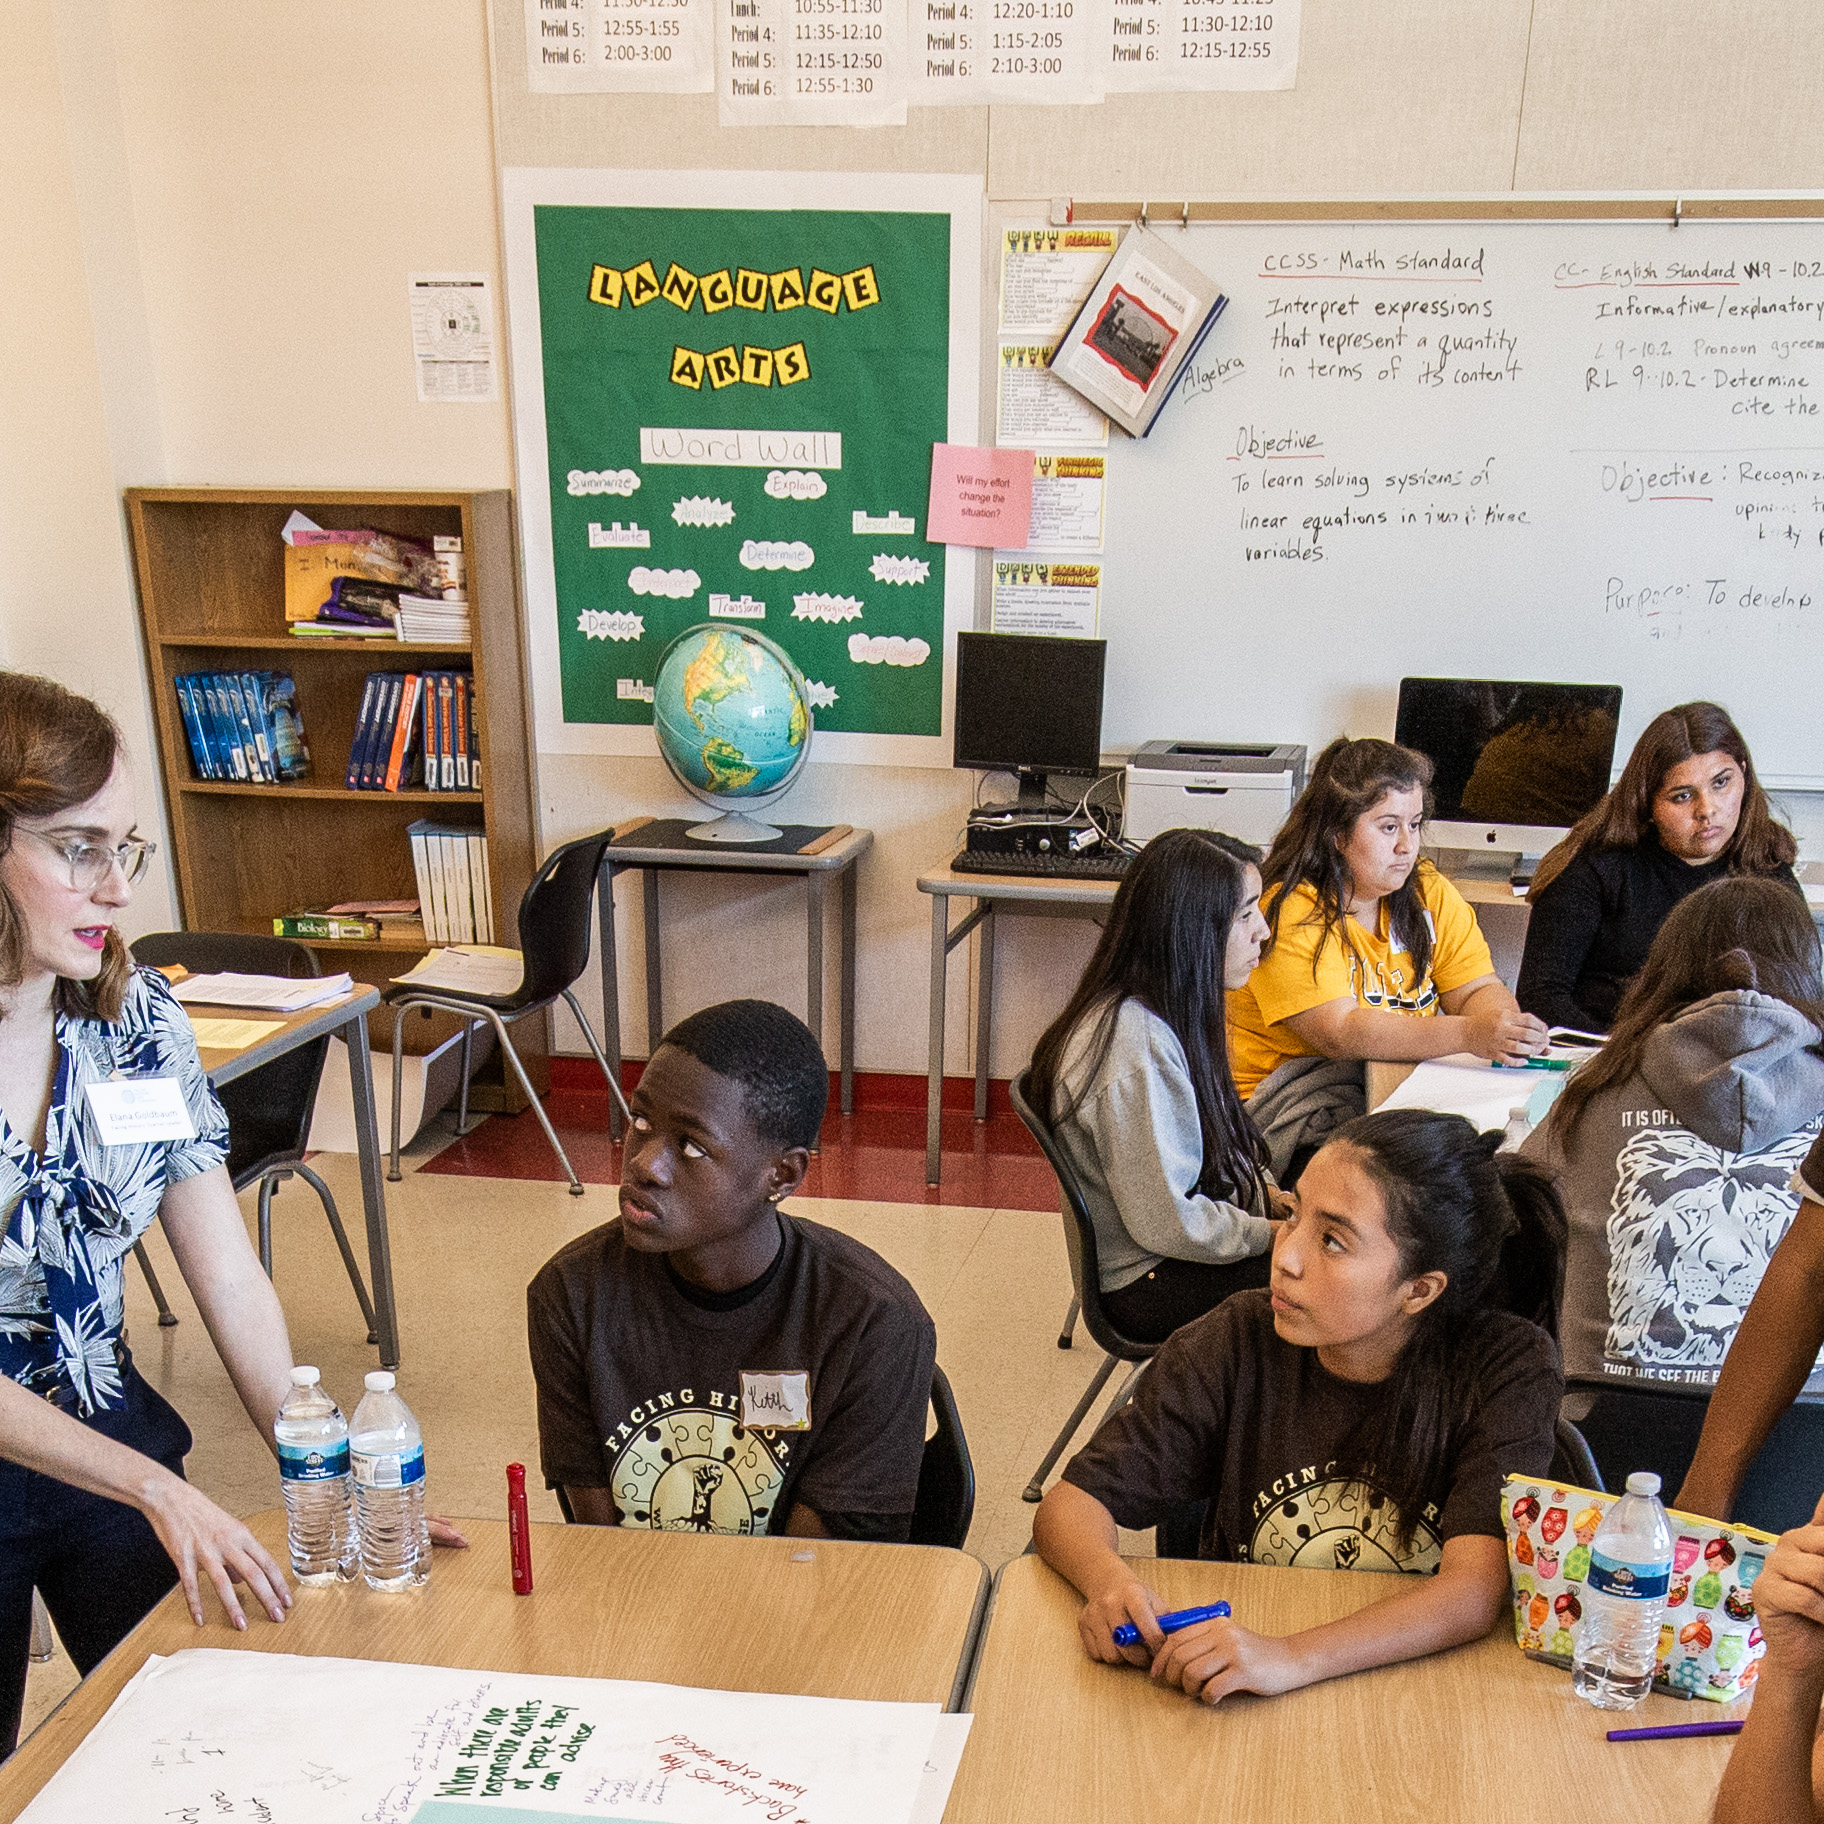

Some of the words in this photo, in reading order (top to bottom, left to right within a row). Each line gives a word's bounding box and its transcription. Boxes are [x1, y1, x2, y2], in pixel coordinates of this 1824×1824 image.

[993, 2, 1074, 19] 12:20-1:10
[541, 20, 568, 37] Period
[572, 22, 585, 37] 5:
[604, 20, 680, 36] 12:55-1:55
[796, 24, 882, 40] 11:35-12:10
[1113, 17, 1142, 36] Period
[1147, 19, 1160, 34] 5:
[1182, 15, 1272, 32] 11:30-12:10
[993, 33, 1063, 49] 1:15-2:05
[542, 47, 569, 65] Period
[573, 48, 586, 64] 6:
[604, 45, 672, 61] 2:00-3:00
[1180, 43, 1271, 59] 12:15-12:55
[796, 53, 882, 69] 12:15-12:50
[732, 78, 760, 96] Period
[763, 80, 776, 95] 6:
[796, 78, 873, 94] 12:55-1:30
[1339, 249, 1386, 272] Math
[592, 264, 877, 312] LANGUAGE
[1265, 298, 1360, 323] Interpret
[1375, 293, 1494, 323] expressions
[1272, 321, 1312, 350] that
[1318, 324, 1408, 355] represent
[1438, 328, 1518, 371] quantity
[672, 345, 806, 388] ARTS
[1279, 358, 1295, 379] in
[1308, 358, 1363, 380] terms
[1377, 355, 1402, 380] of
[1182, 357, 1245, 395] Algebra
[1714, 367, 1809, 390] Determine
[1731, 396, 1774, 416] cite
[1784, 396, 1821, 416] the
[650, 430, 740, 461] Word
[759, 434, 829, 465] Wall
[1236, 424, 1324, 459] Objective
[572, 476, 632, 490] Summarize
[773, 476, 818, 493] Explain
[990, 478, 1010, 487] effort
[1231, 474, 1250, 493] To
[1262, 468, 1304, 488] learn
[1314, 466, 1370, 498] solving
[959, 491, 991, 504] change
[855, 513, 910, 530] Describe
[961, 508, 1001, 518] situation?
[1240, 507, 1287, 529] linear
[1302, 506, 1388, 545] equations
[746, 545, 806, 561] Determine
[878, 559, 920, 576] Support
[715, 597, 763, 615] Transform
[800, 597, 855, 616] Imagine
[588, 616, 636, 633] Develop
[297, 921, 328, 937] Biology
[1621, 1110, 1632, 1127] IT
[1636, 1109, 1649, 1127] IS
[605, 1388, 695, 1453] FACING
[509, 1699, 543, 1738] adults
[433, 1764, 479, 1797] When
[458, 1729, 498, 1758] there
[483, 1706, 510, 1726] are
